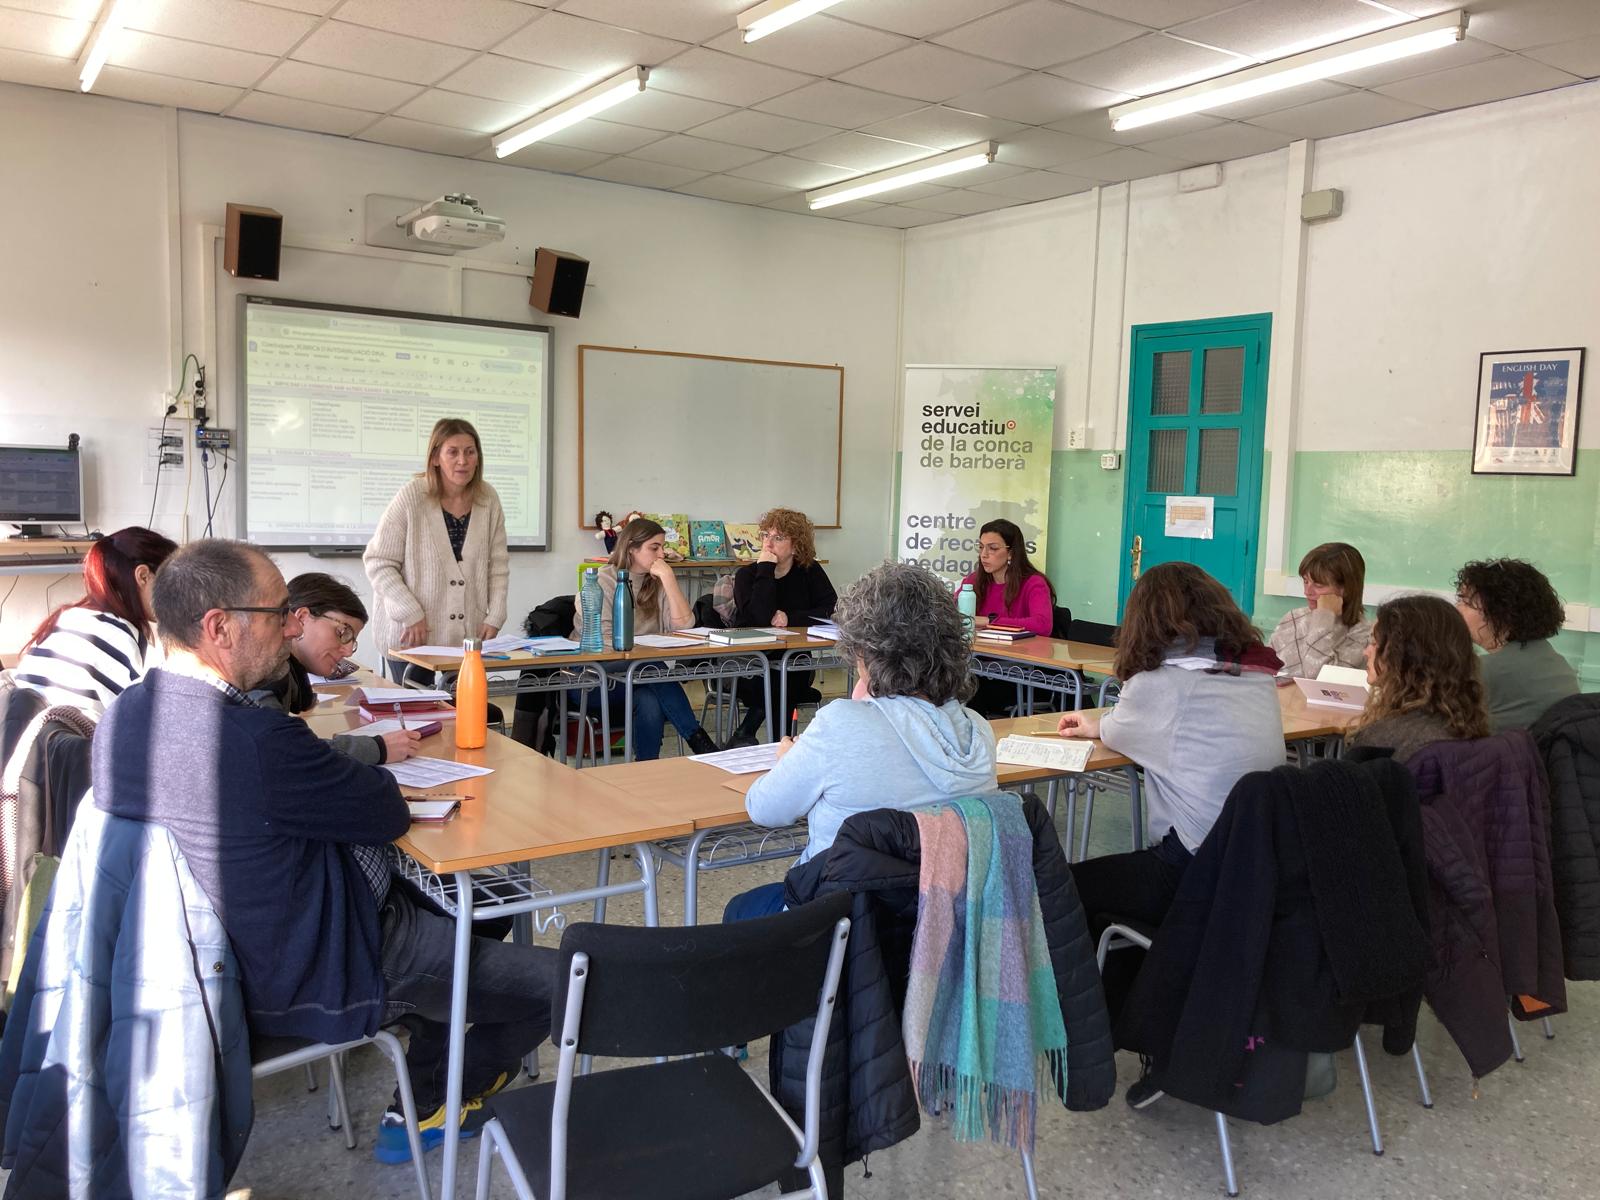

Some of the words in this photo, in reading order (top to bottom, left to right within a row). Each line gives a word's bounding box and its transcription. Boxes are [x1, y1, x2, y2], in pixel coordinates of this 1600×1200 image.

[1502, 364, 1537, 373] ENGLISH
[1539, 363, 1558, 371] DAY
[922, 402, 980, 418] servei
[921, 418, 1006, 435] educatiu
[920, 435, 944, 451] de
[950, 435, 967, 452] la
[973, 439, 1033, 453] conca
[920, 452, 944, 468] de
[949, 453, 1026, 470] barberà
[907, 512, 977, 530] centre
[905, 532, 933, 550] de
